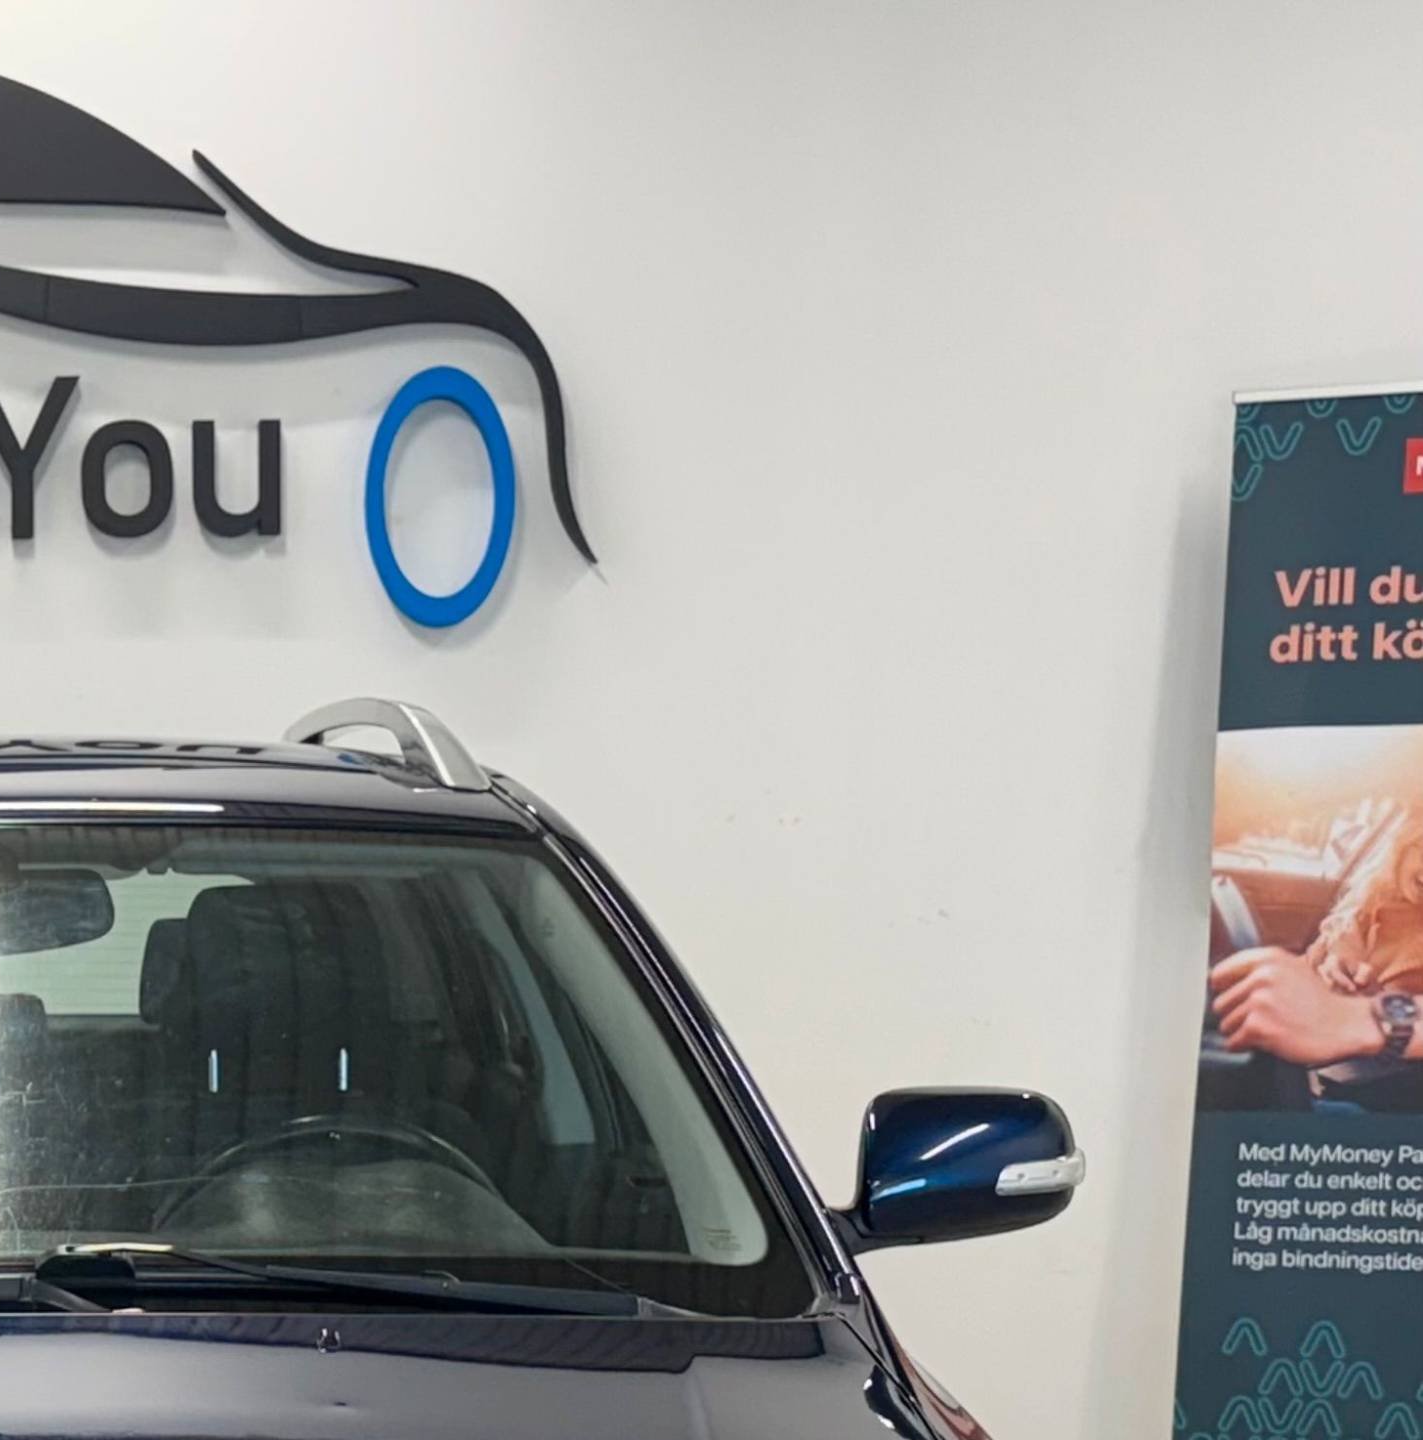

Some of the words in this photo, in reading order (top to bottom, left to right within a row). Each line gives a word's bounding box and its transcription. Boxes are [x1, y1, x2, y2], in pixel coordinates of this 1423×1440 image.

[1275, 567, 1357, 608] Vill
[1269, 621, 1358, 663] ditt
[1238, 1143, 1285, 1162] Med
[1289, 1143, 1394, 1167] MyMoney
[1237, 1170, 1290, 1188] delar
[1294, 1171, 1323, 1189] du
[1327, 1172, 1392, 1190] enkelt
[1236, 1197, 1300, 1219] tryggt
[1304, 1201, 1346, 1219] upp
[1350, 1198, 1386, 1217] ditt
[1234, 1221, 1273, 1245] Låg
[1232, 1248, 1277, 1271] inga
